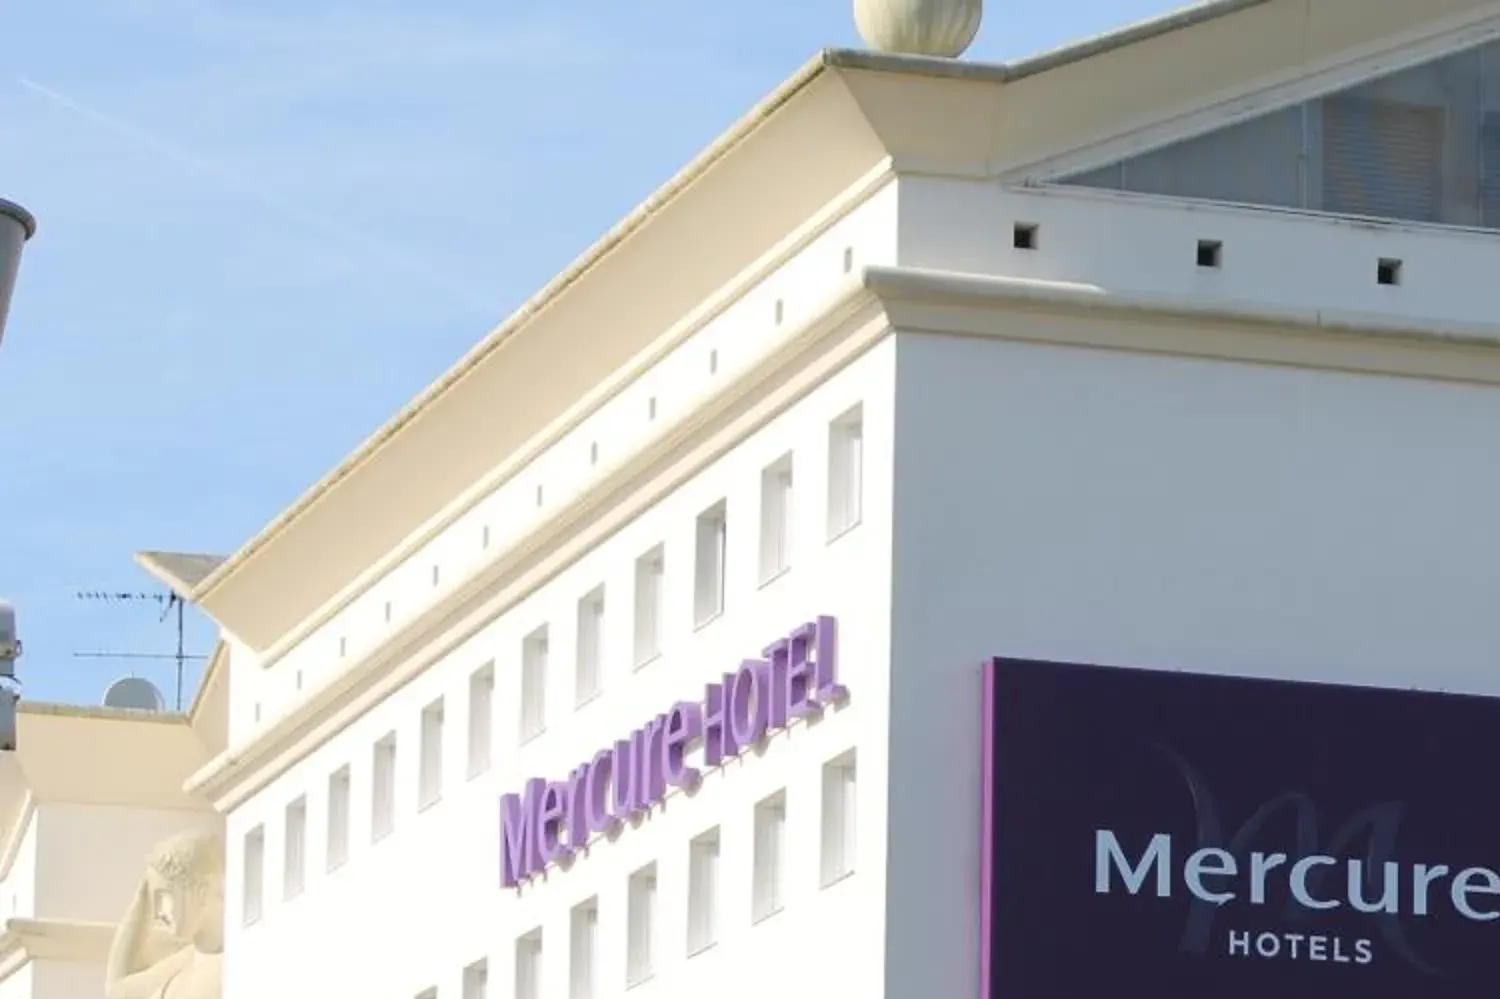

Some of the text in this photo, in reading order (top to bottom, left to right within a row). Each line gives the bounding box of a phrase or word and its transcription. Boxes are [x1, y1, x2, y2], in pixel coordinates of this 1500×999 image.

[500, 615, 850, 889] Mercure HOTEL
[1228, 930, 1373, 964] HOTELS
